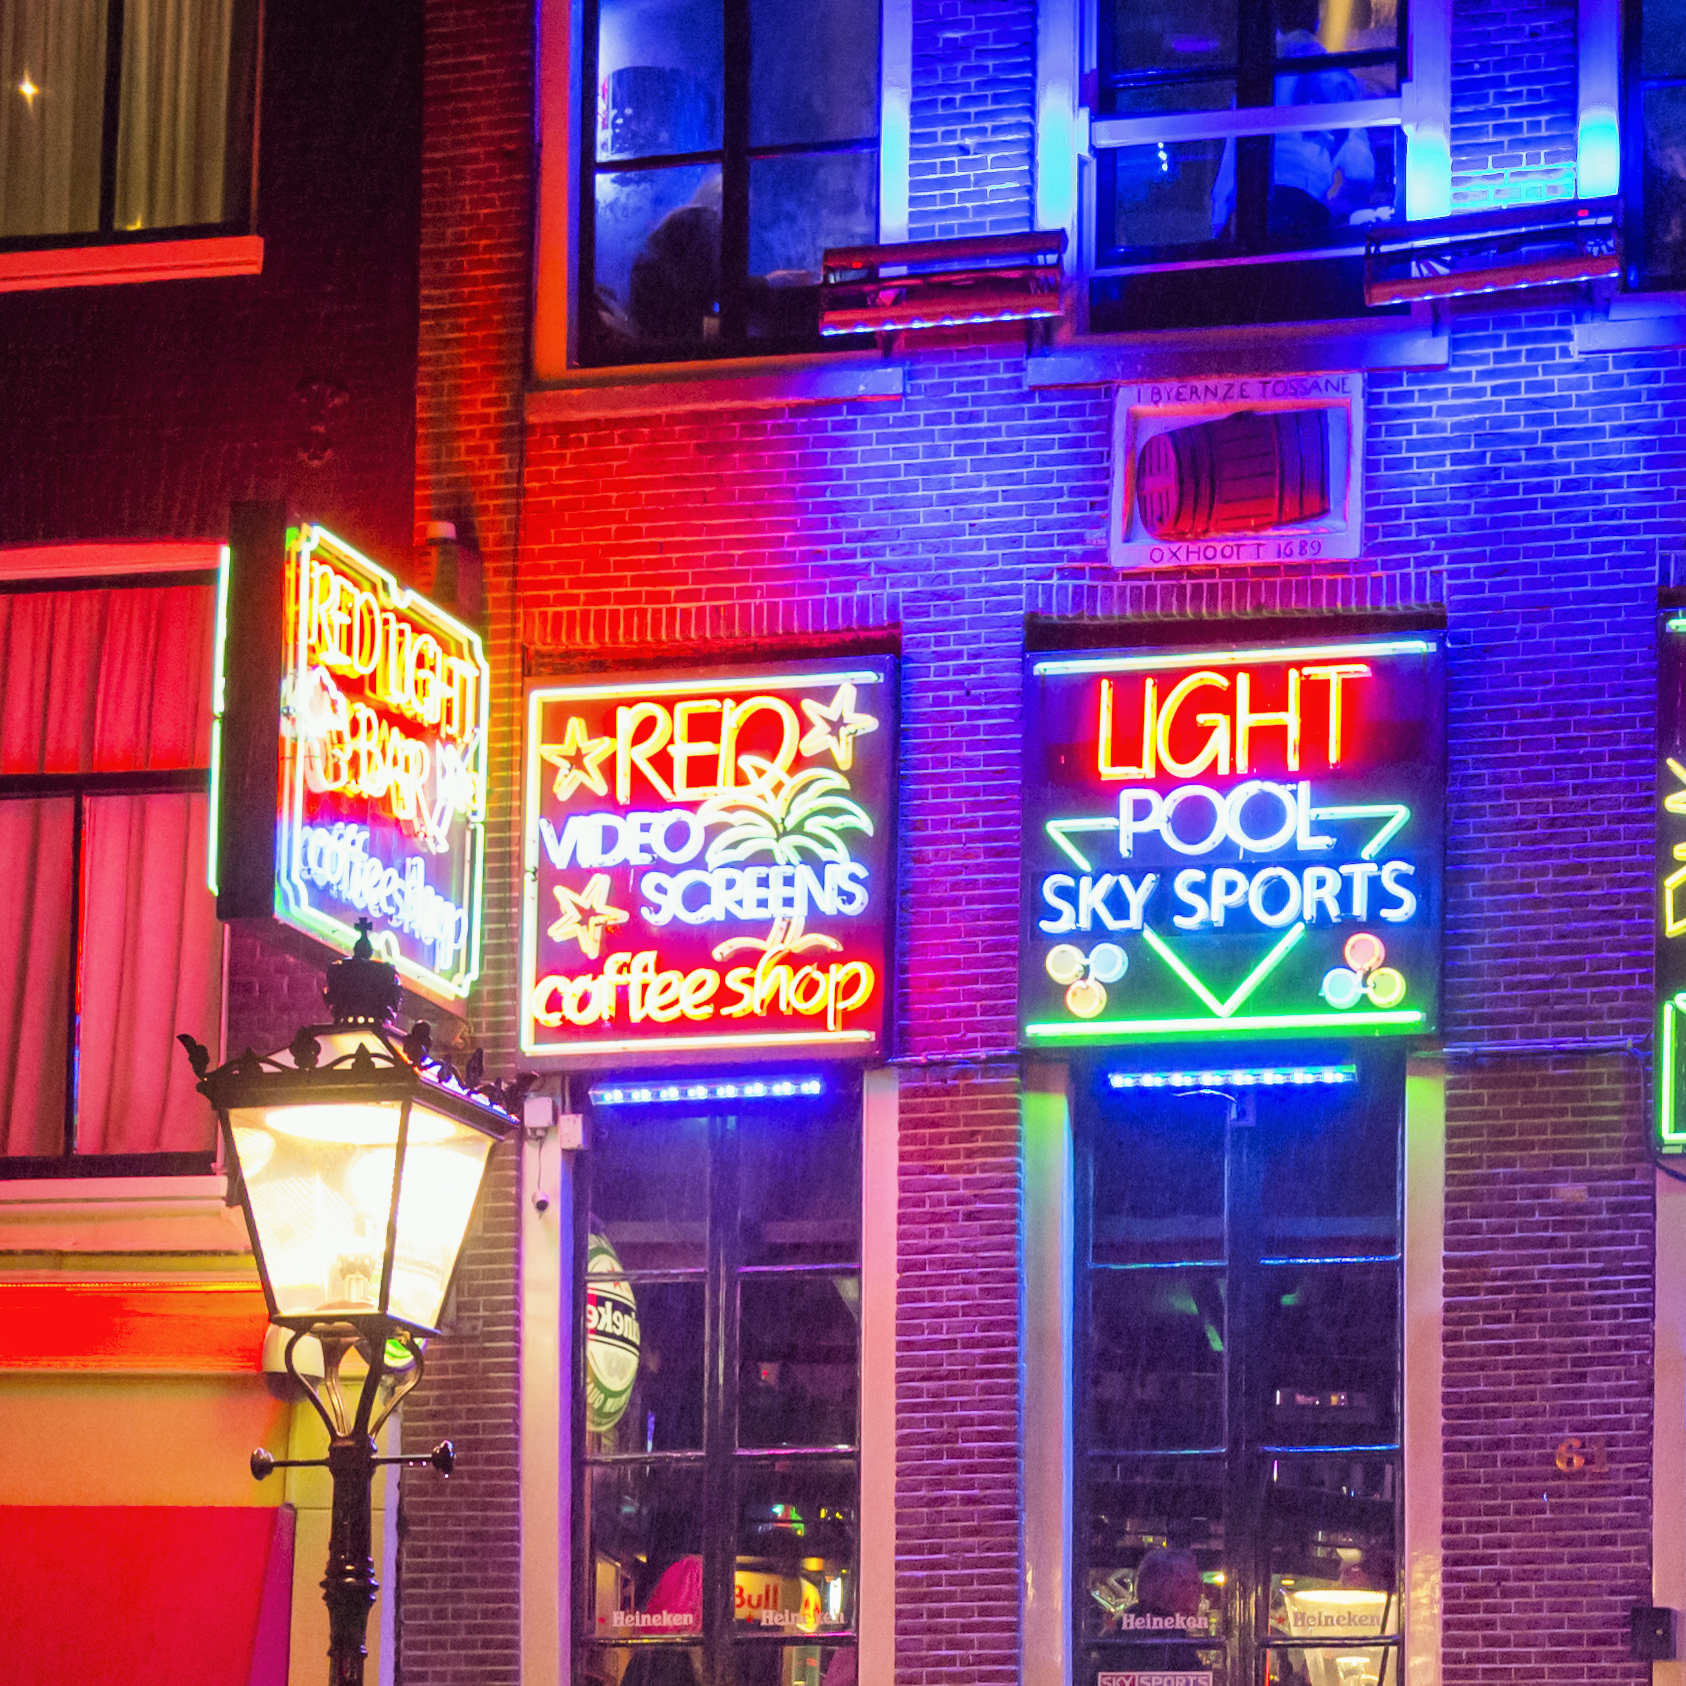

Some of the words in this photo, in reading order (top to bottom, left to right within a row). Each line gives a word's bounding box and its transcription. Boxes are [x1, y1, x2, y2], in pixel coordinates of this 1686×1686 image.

[1276, 540, 1322, 559] 1689
[309, 559, 382, 680] RED
[615, 695, 801, 806] RED
[1097, 663, 1372, 780] LIGHT
[350, 701, 431, 823] BAR
[538, 808, 705, 870] VIDEO
[1117, 780, 1337, 859] POOL
[640, 861, 870, 927] SCREENS
[1038, 871, 1158, 935] SKY
[1173, 859, 1419, 930] SPORTS
[612, 1610, 694, 1628] Heineken
[1121, 1612, 1209, 1630] Heineken
[1292, 1610, 1382, 1628] Heineken
